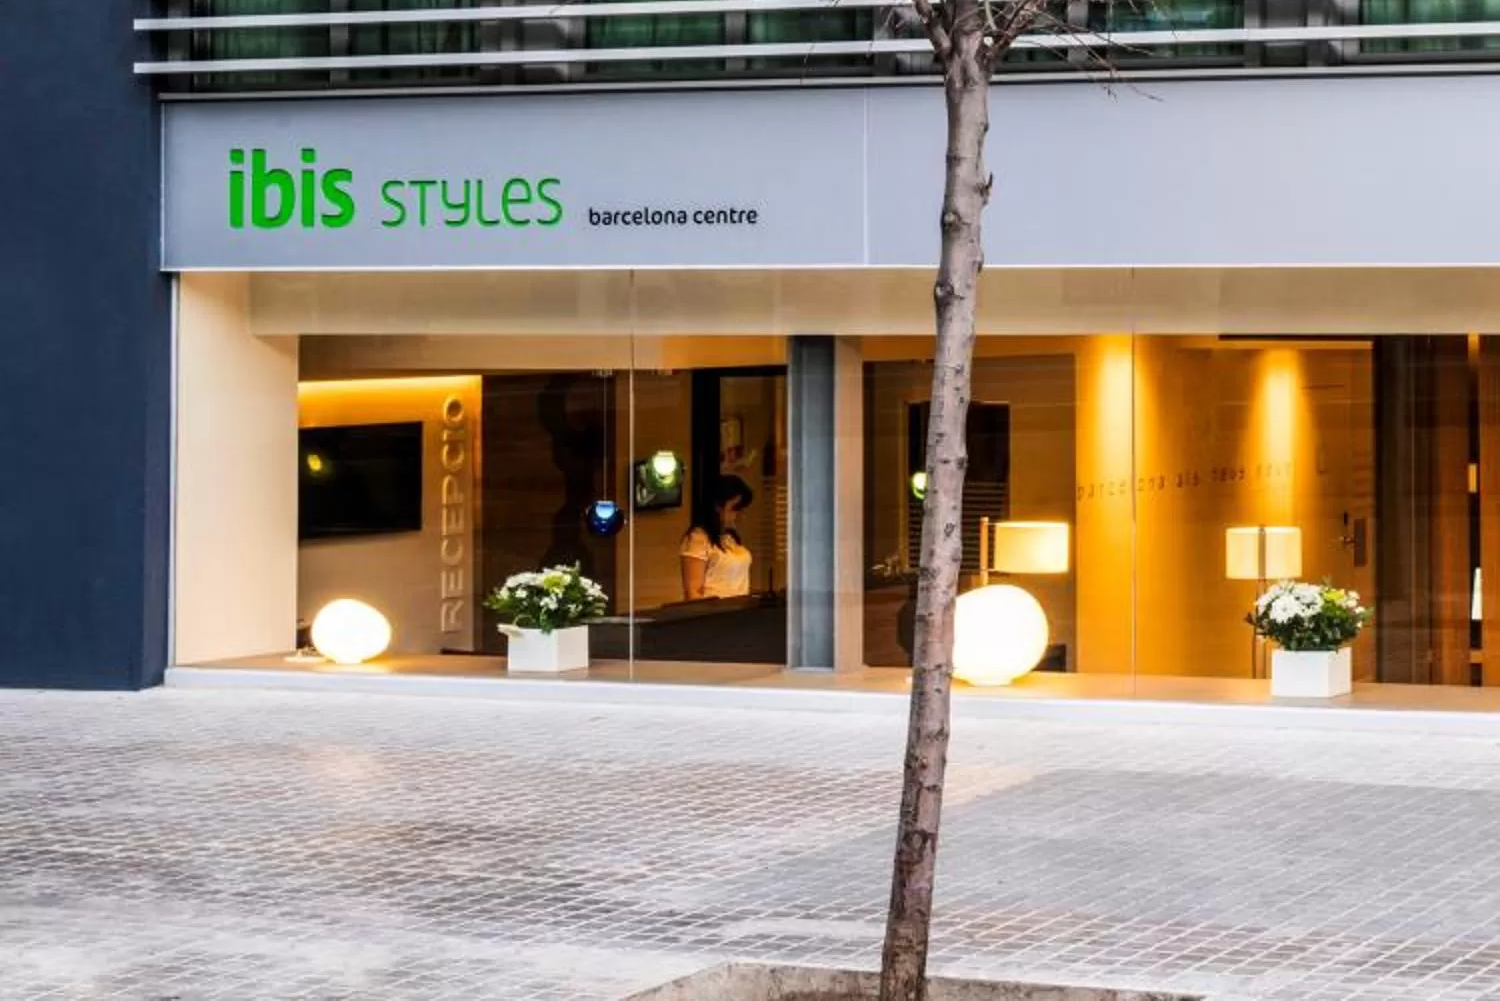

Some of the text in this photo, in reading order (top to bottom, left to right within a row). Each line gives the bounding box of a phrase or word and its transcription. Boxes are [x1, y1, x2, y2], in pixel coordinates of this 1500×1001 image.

[228, 147, 356, 229] ibis
[588, 206, 688, 226] barcelona
[692, 207, 759, 225] centre
